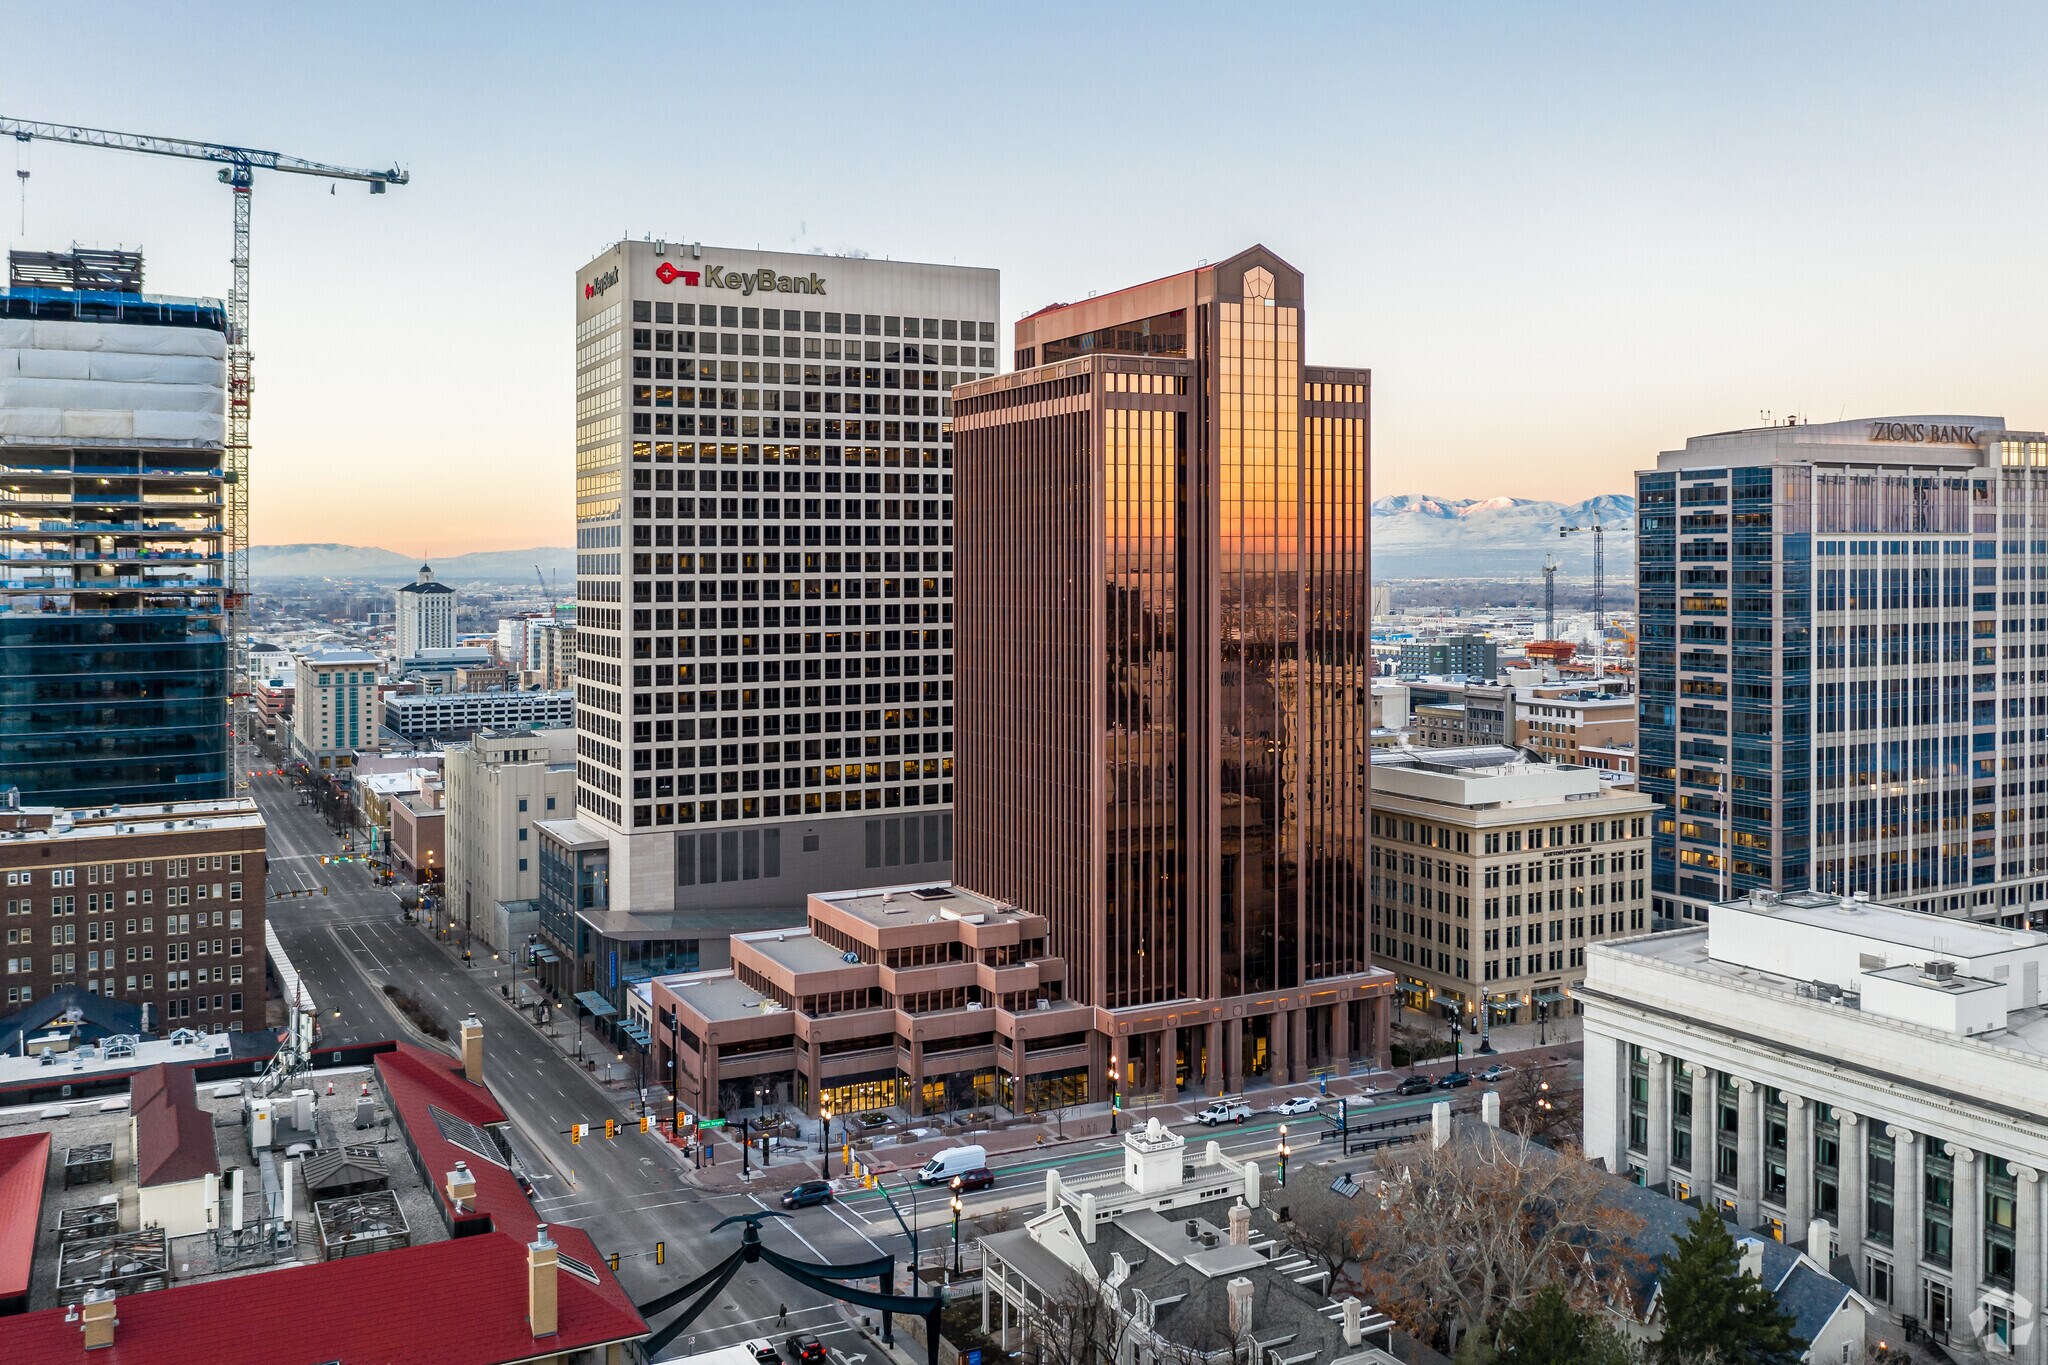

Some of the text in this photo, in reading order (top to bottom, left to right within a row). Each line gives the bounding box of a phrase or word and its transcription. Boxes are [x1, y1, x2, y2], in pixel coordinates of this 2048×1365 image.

[594, 265, 619, 297] KeyBank
[705, 264, 826, 296] KeyBank
[1874, 421, 1976, 444] ZIONS BANK
